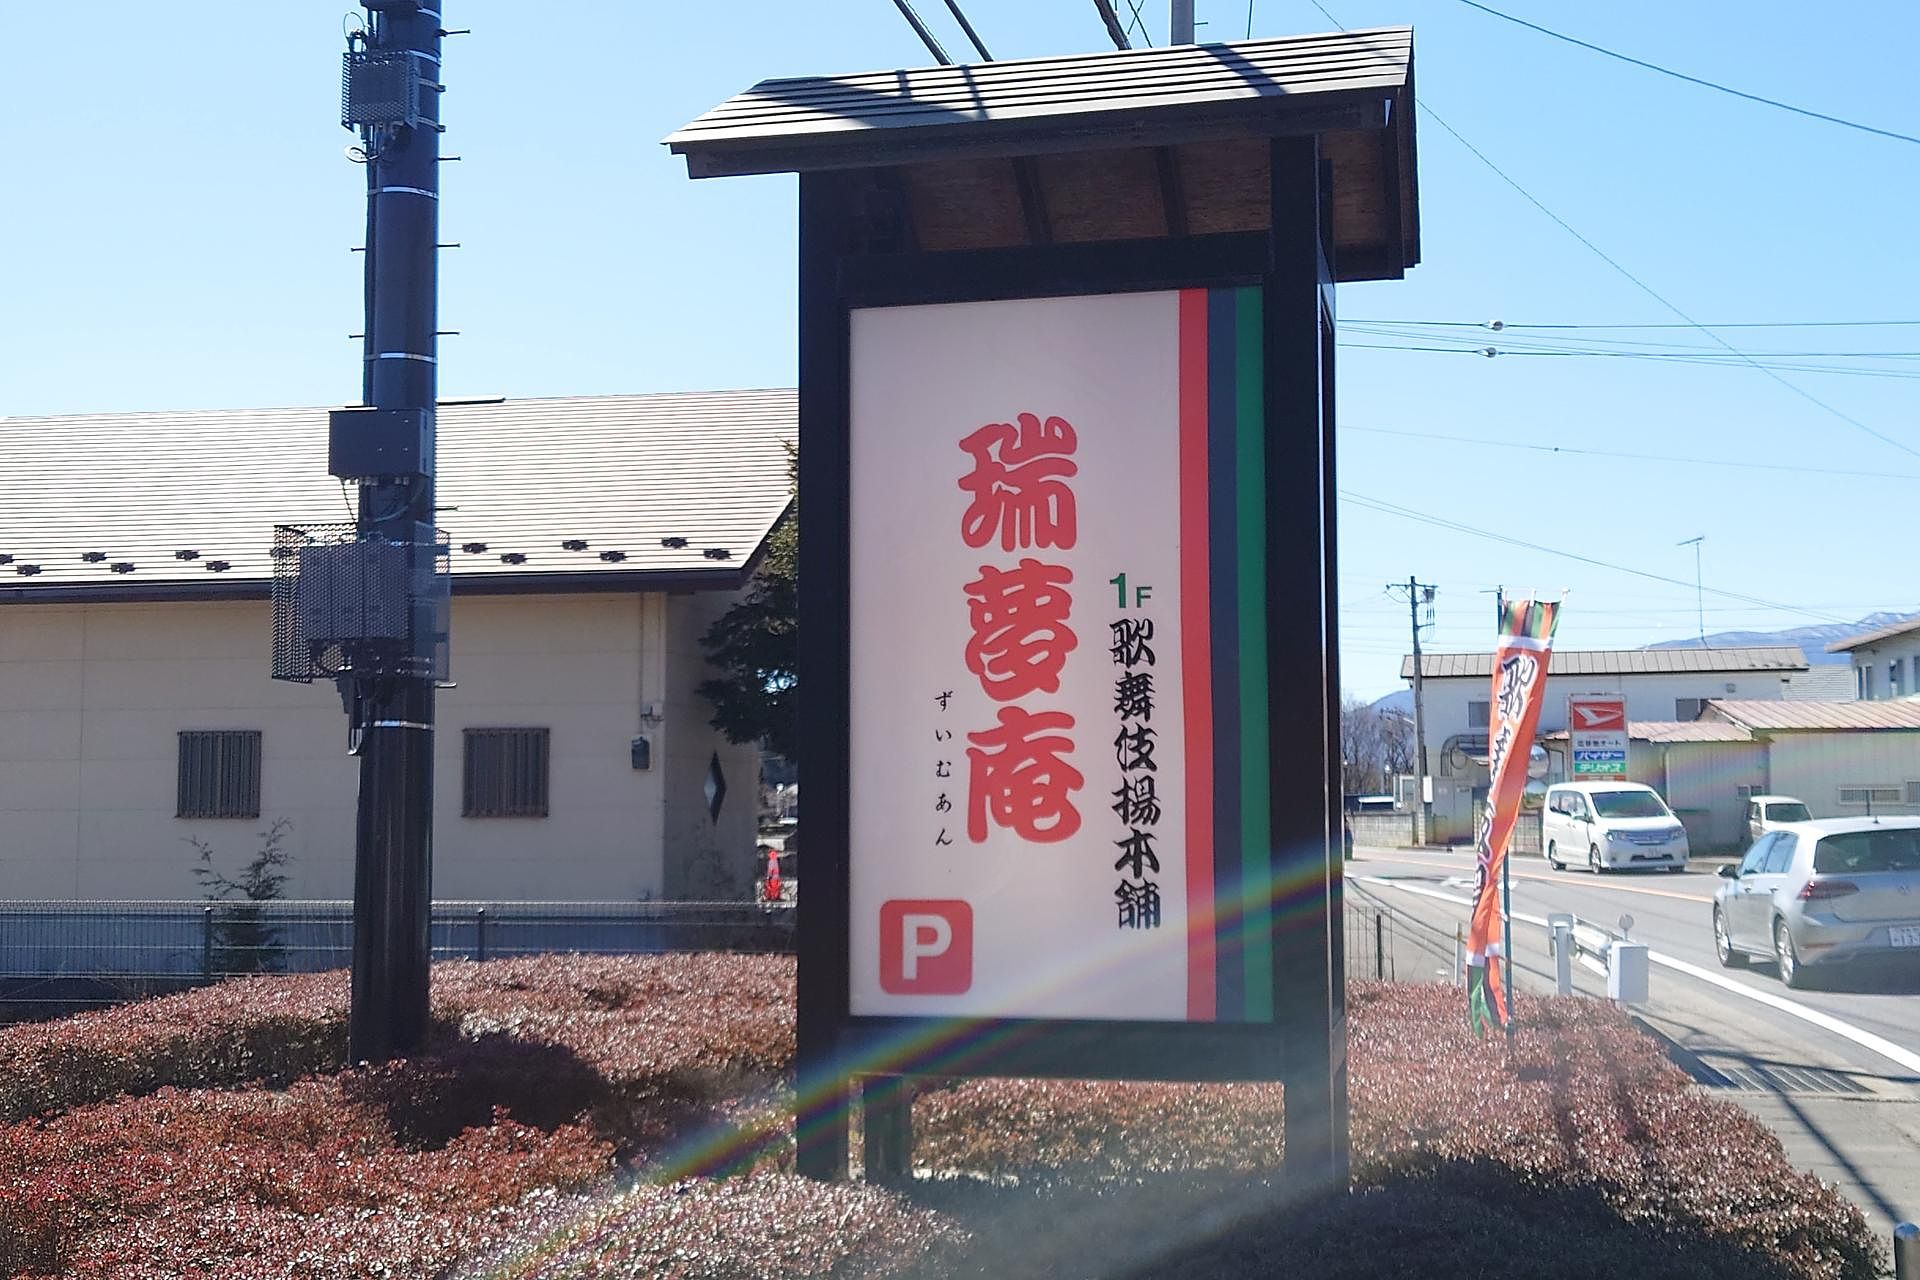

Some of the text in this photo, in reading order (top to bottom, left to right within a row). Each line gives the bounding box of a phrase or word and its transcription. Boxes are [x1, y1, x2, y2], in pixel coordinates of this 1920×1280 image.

[958, 412, 1085, 844] 瑞夢庵
[1109, 572, 1153, 608] 1F
[933, 690, 954, 848] ずいむあん
[901, 913, 953, 981] P
